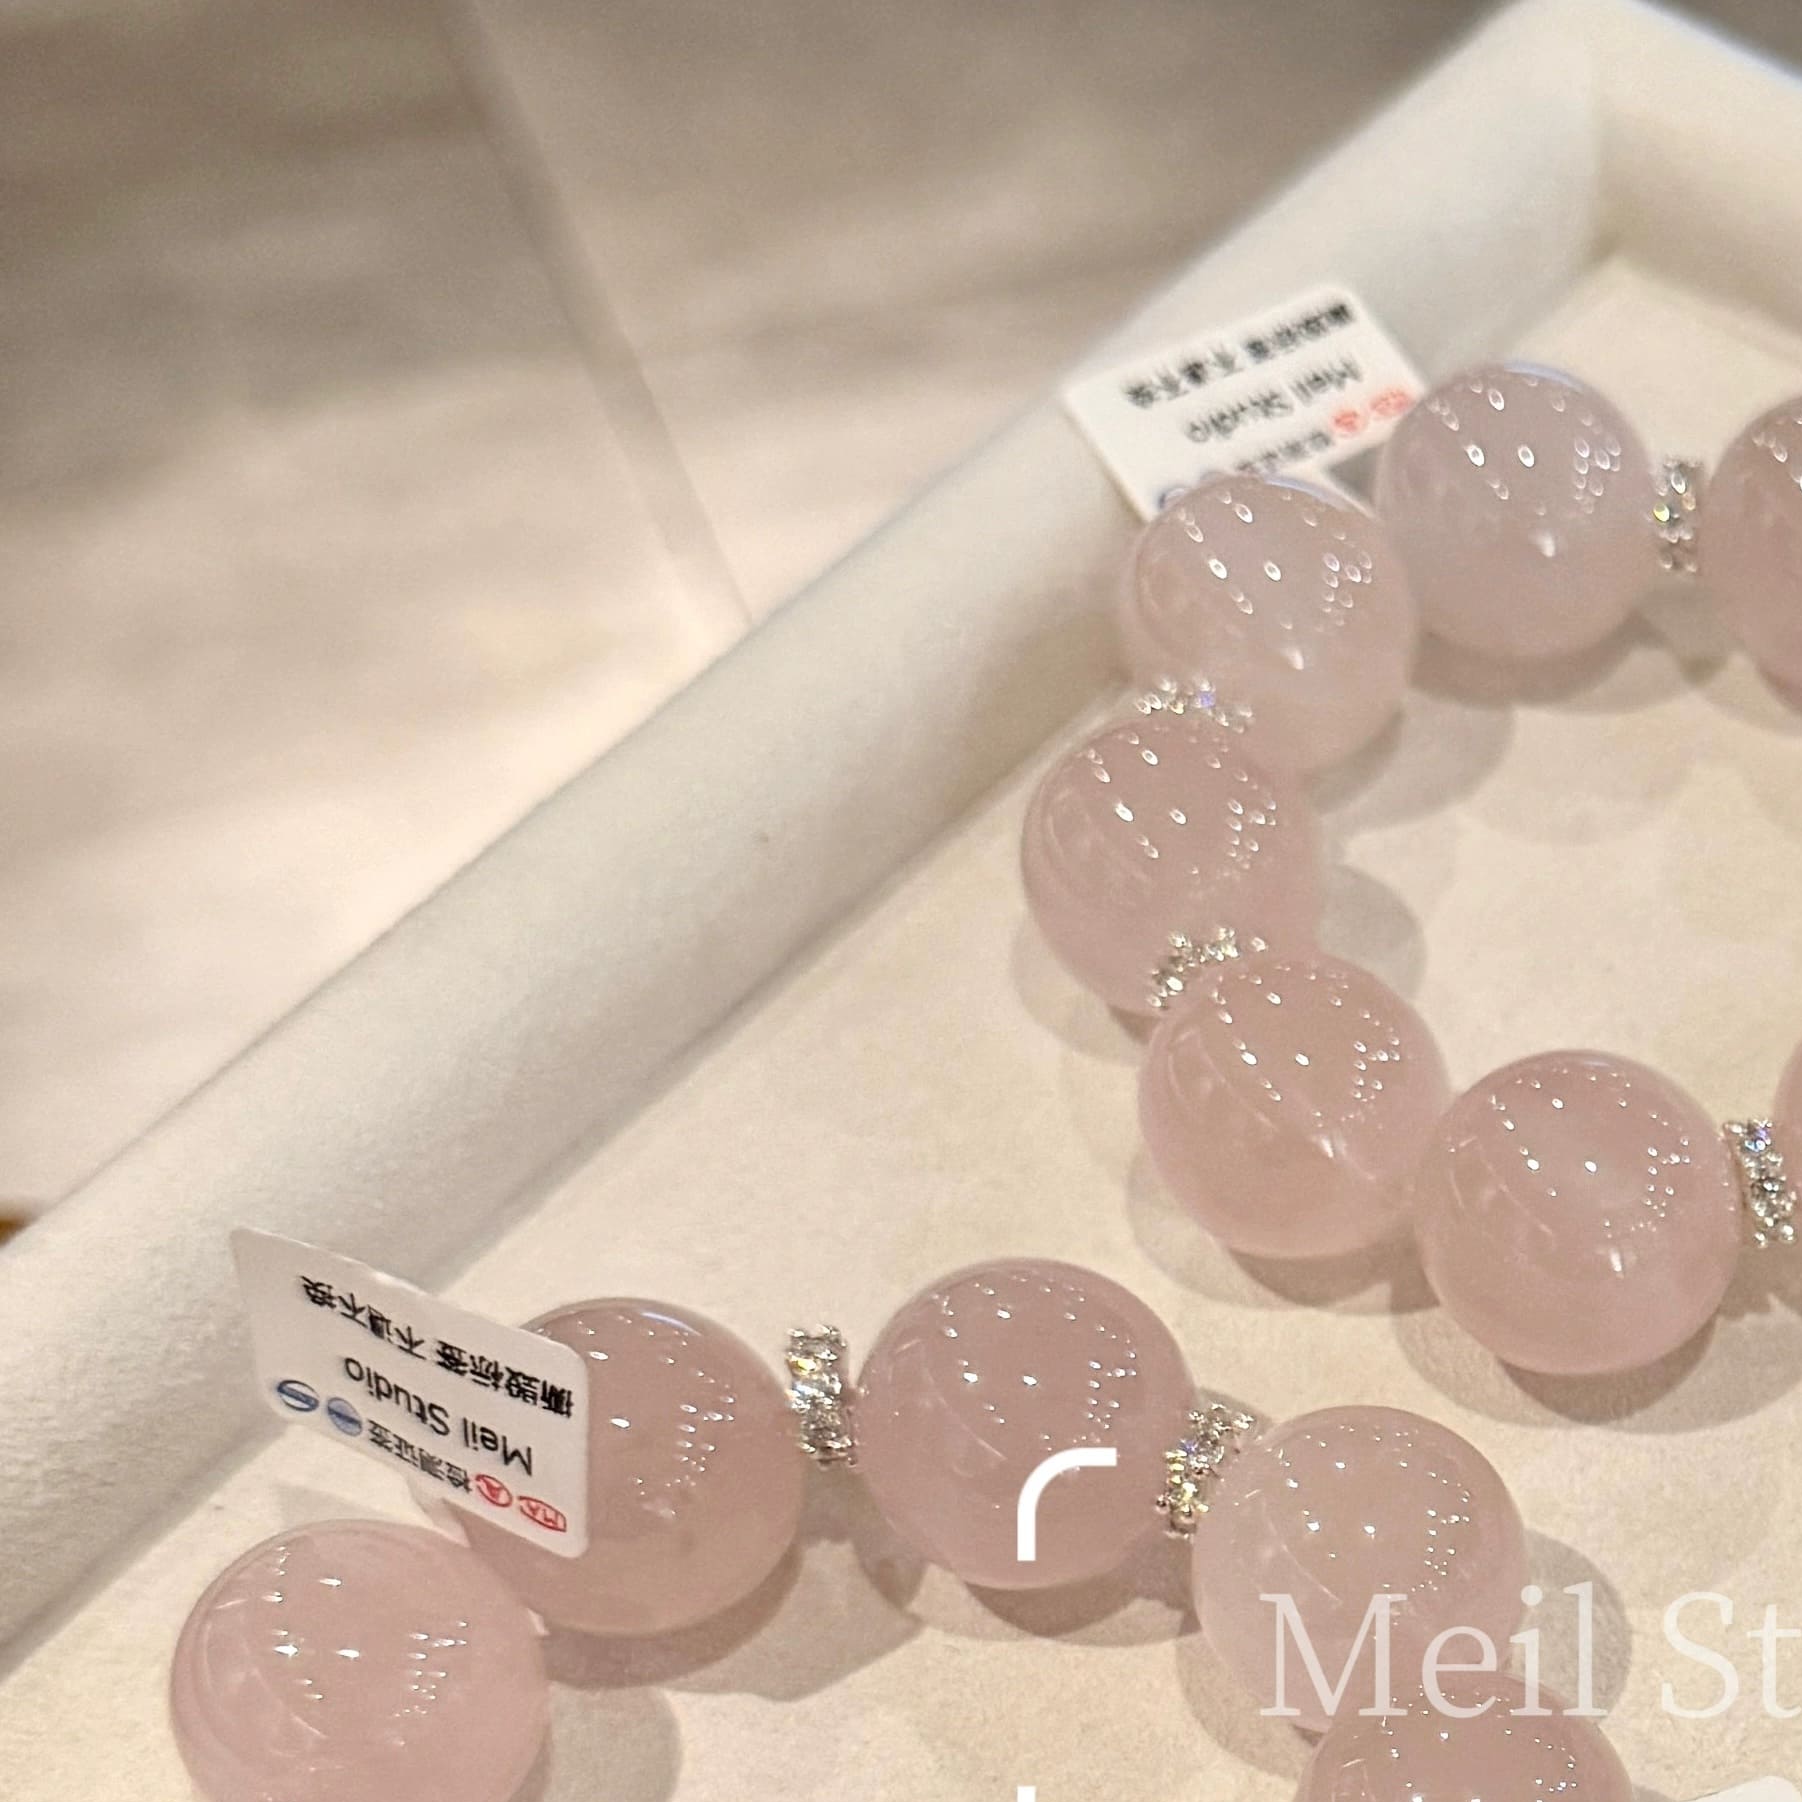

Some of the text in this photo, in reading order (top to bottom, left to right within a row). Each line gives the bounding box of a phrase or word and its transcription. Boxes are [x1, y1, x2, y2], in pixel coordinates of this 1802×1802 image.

[299, 1275, 574, 1419] 撕毁标签 不退不换
[343, 1357, 451, 1437] Studio
[462, 1417, 533, 1477] Meil
